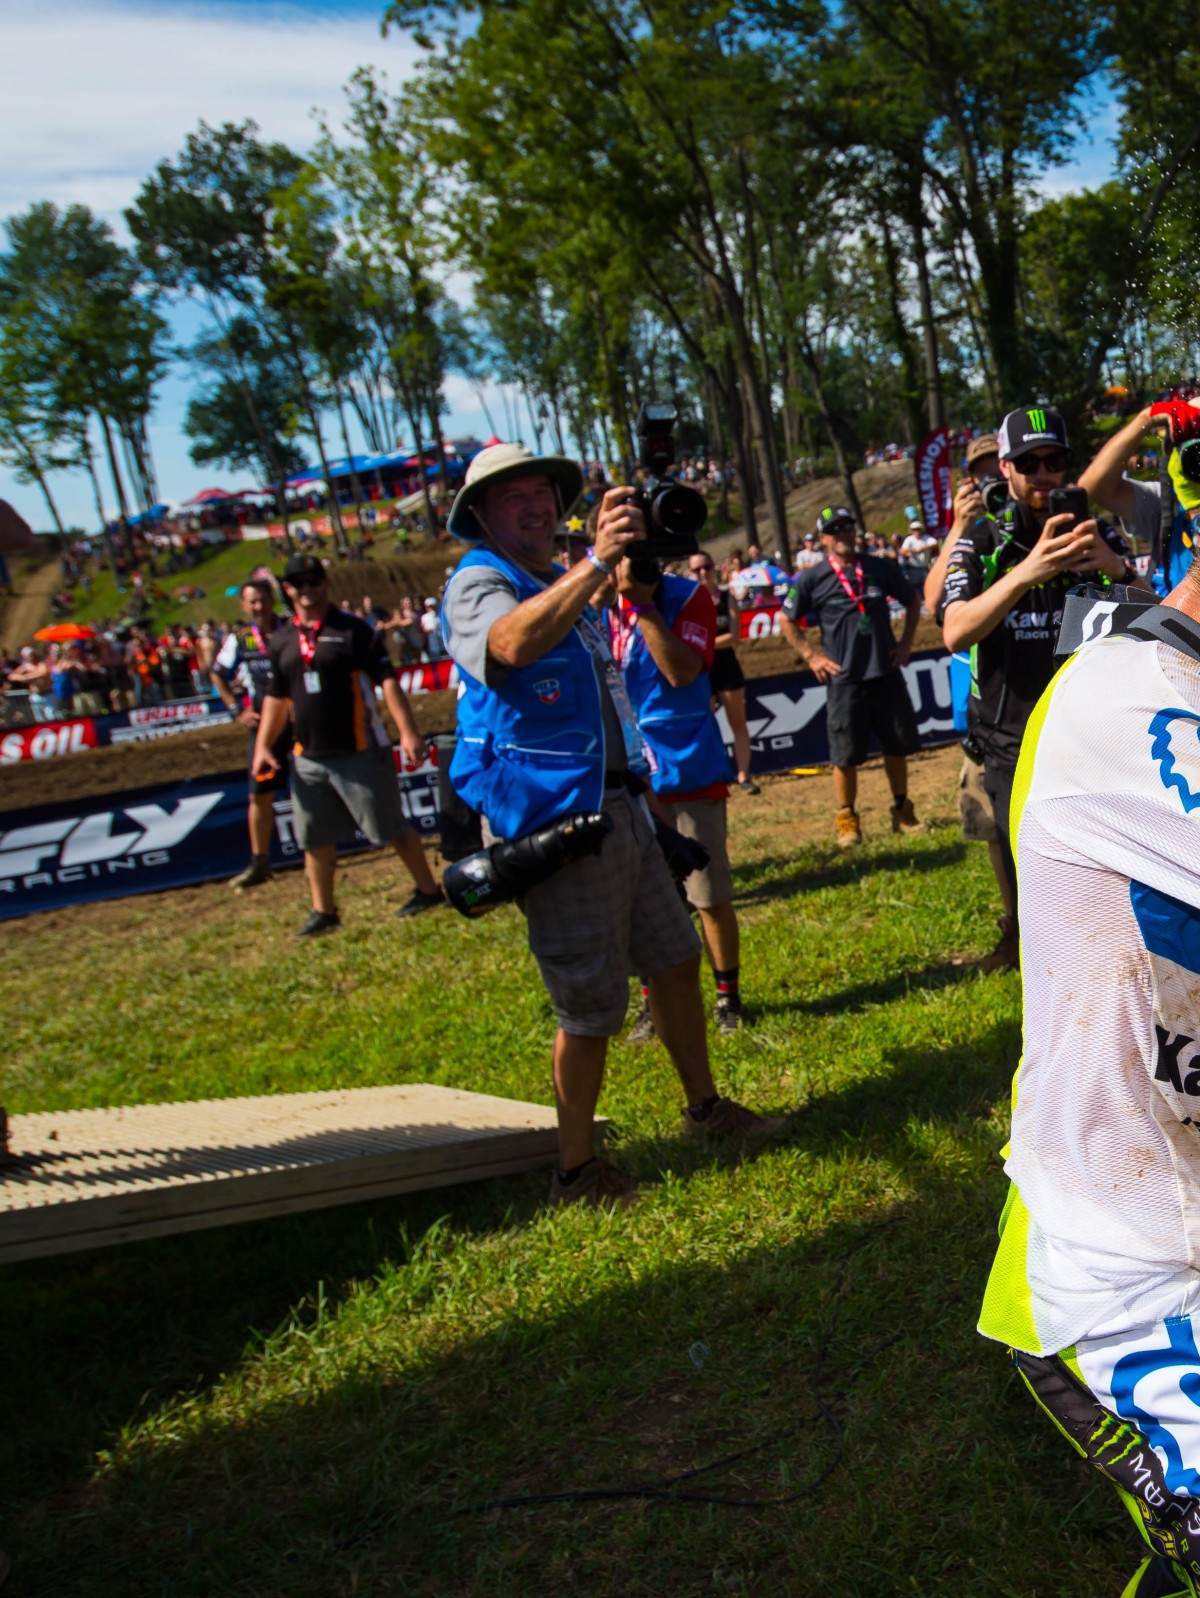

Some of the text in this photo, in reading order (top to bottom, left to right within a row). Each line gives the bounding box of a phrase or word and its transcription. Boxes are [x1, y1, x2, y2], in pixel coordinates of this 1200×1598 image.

[919, 432, 947, 527] HOLESHOT
[30, 723, 91, 760] OIL
[0, 791, 226, 880] FLY
